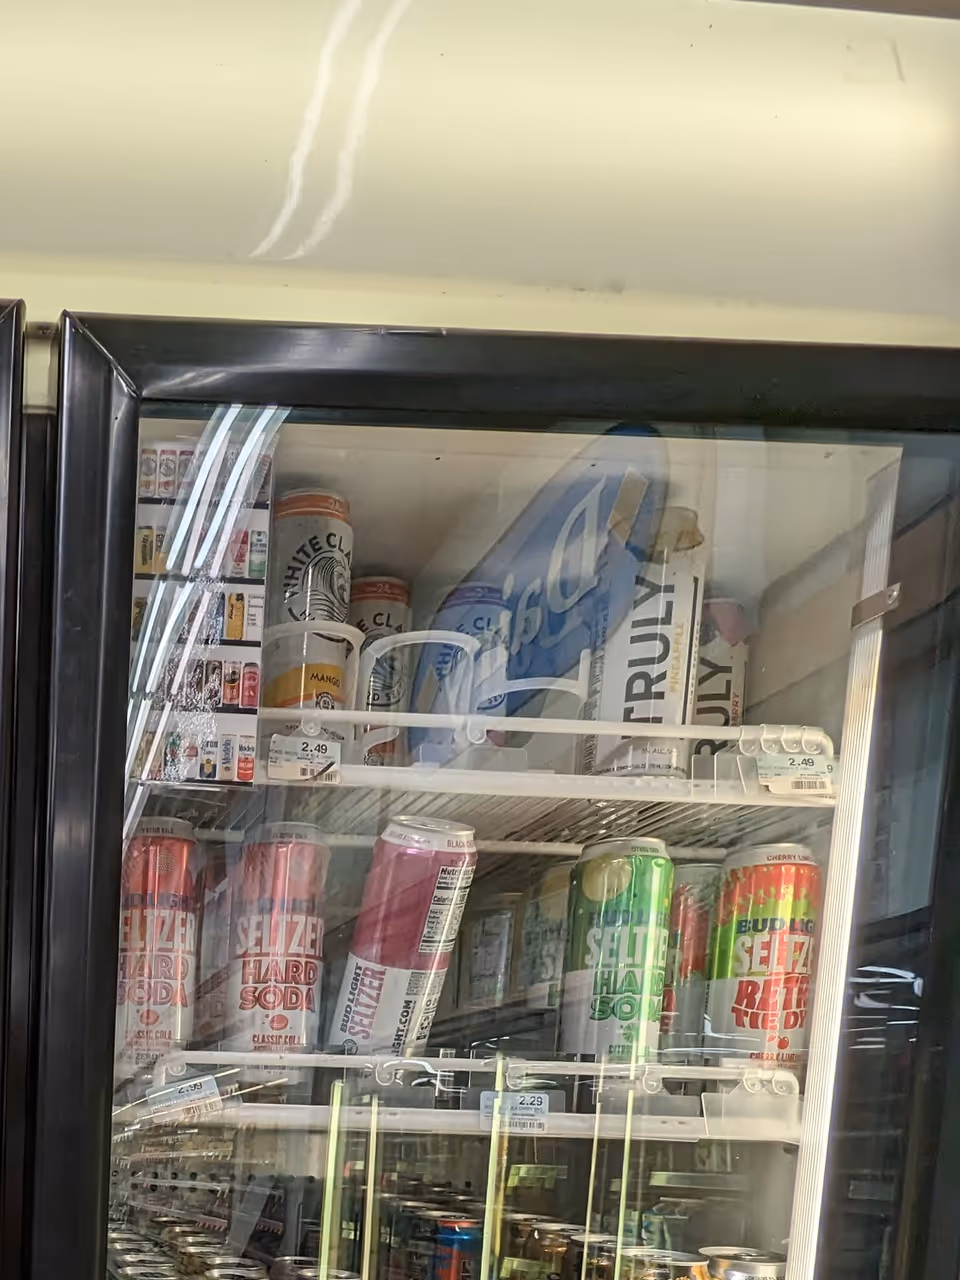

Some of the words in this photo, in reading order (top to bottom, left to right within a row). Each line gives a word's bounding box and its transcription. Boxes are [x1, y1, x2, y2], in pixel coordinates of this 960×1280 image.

[695, 657, 732, 756] RULY
[301, 741, 328, 754] 2.49
[788, 757, 815, 768] 2.49
[120, 908, 196, 951] ELTZER
[236, 914, 324, 955] SELTZER
[736, 917, 785, 934] BUD
[242, 958, 319, 986] HARD
[346, 962, 364, 1004] LIGHT
[239, 985, 317, 1013] SODA
[347, 965, 388, 1041] SELTZER
[340, 1006, 354, 1034] BUD
[732, 1005, 780, 1030] TIE
[252, 1033, 282, 1046] CLASSIC
[519, 1096, 543, 1107] 2.29
